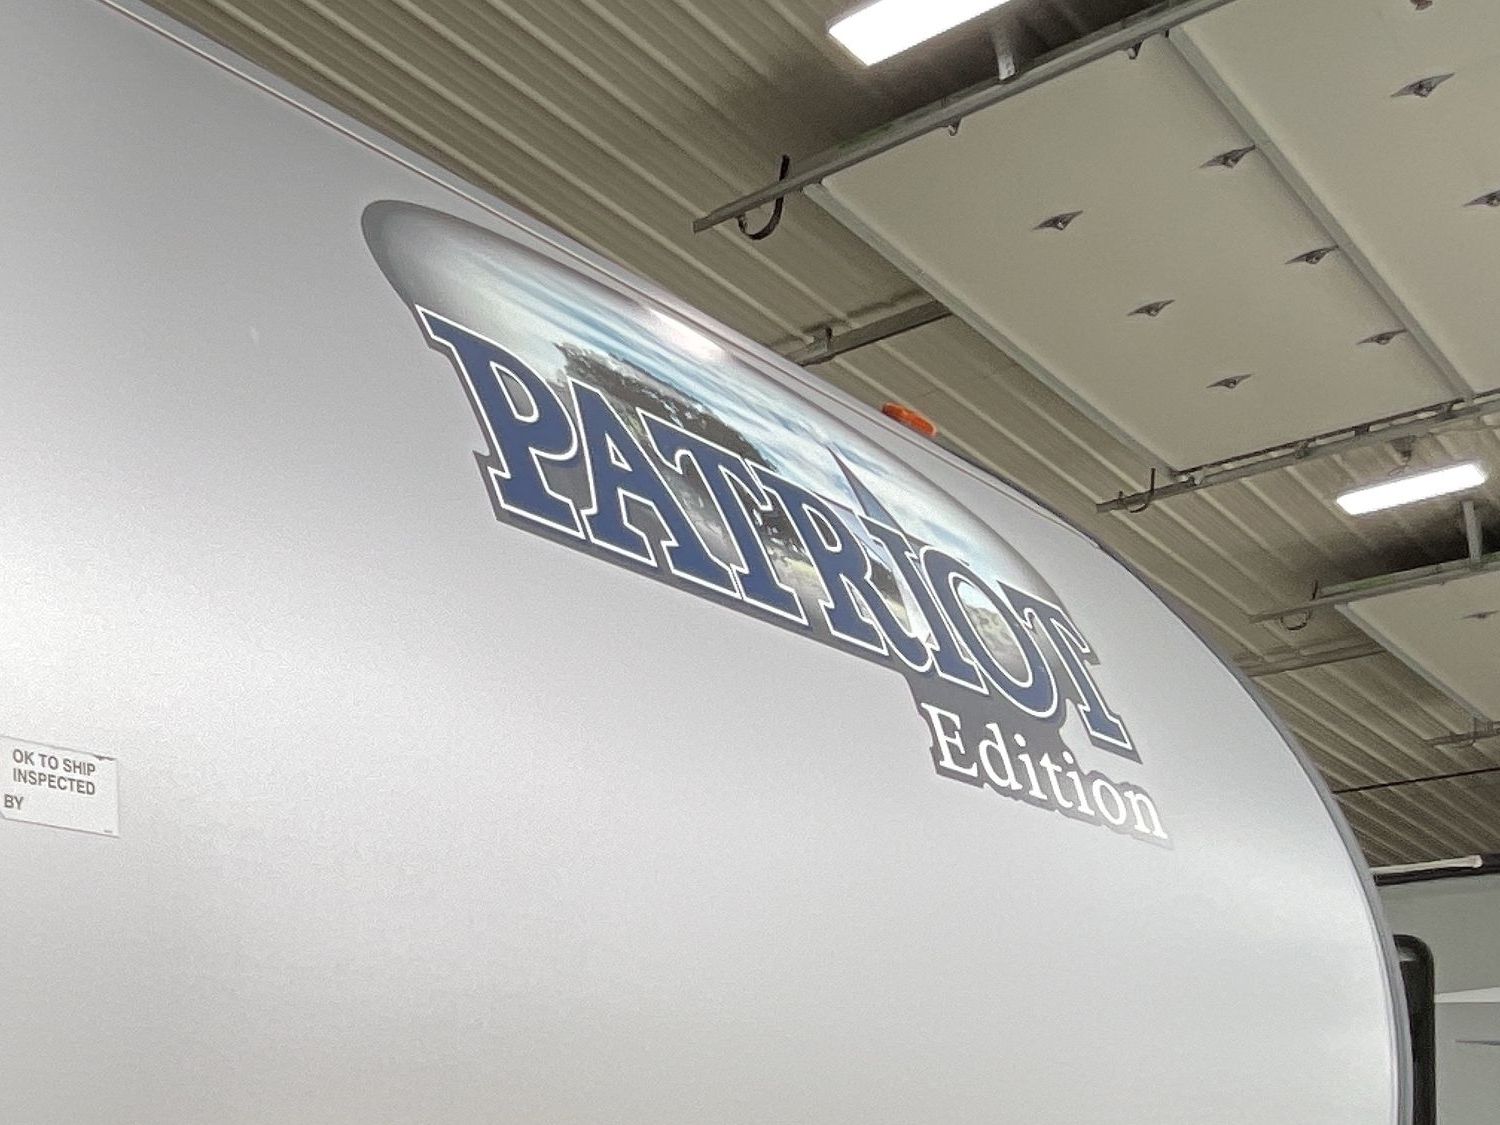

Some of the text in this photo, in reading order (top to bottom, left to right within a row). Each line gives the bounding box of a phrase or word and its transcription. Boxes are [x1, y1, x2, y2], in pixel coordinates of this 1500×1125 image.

[415, 303, 1136, 752] PATRIOT
[13, 749, 96, 776] OK TO SHIP
[920, 702, 1169, 840] Edition
[13, 768, 96, 795] INSPECTED
[4, 794, 24, 810] BY
